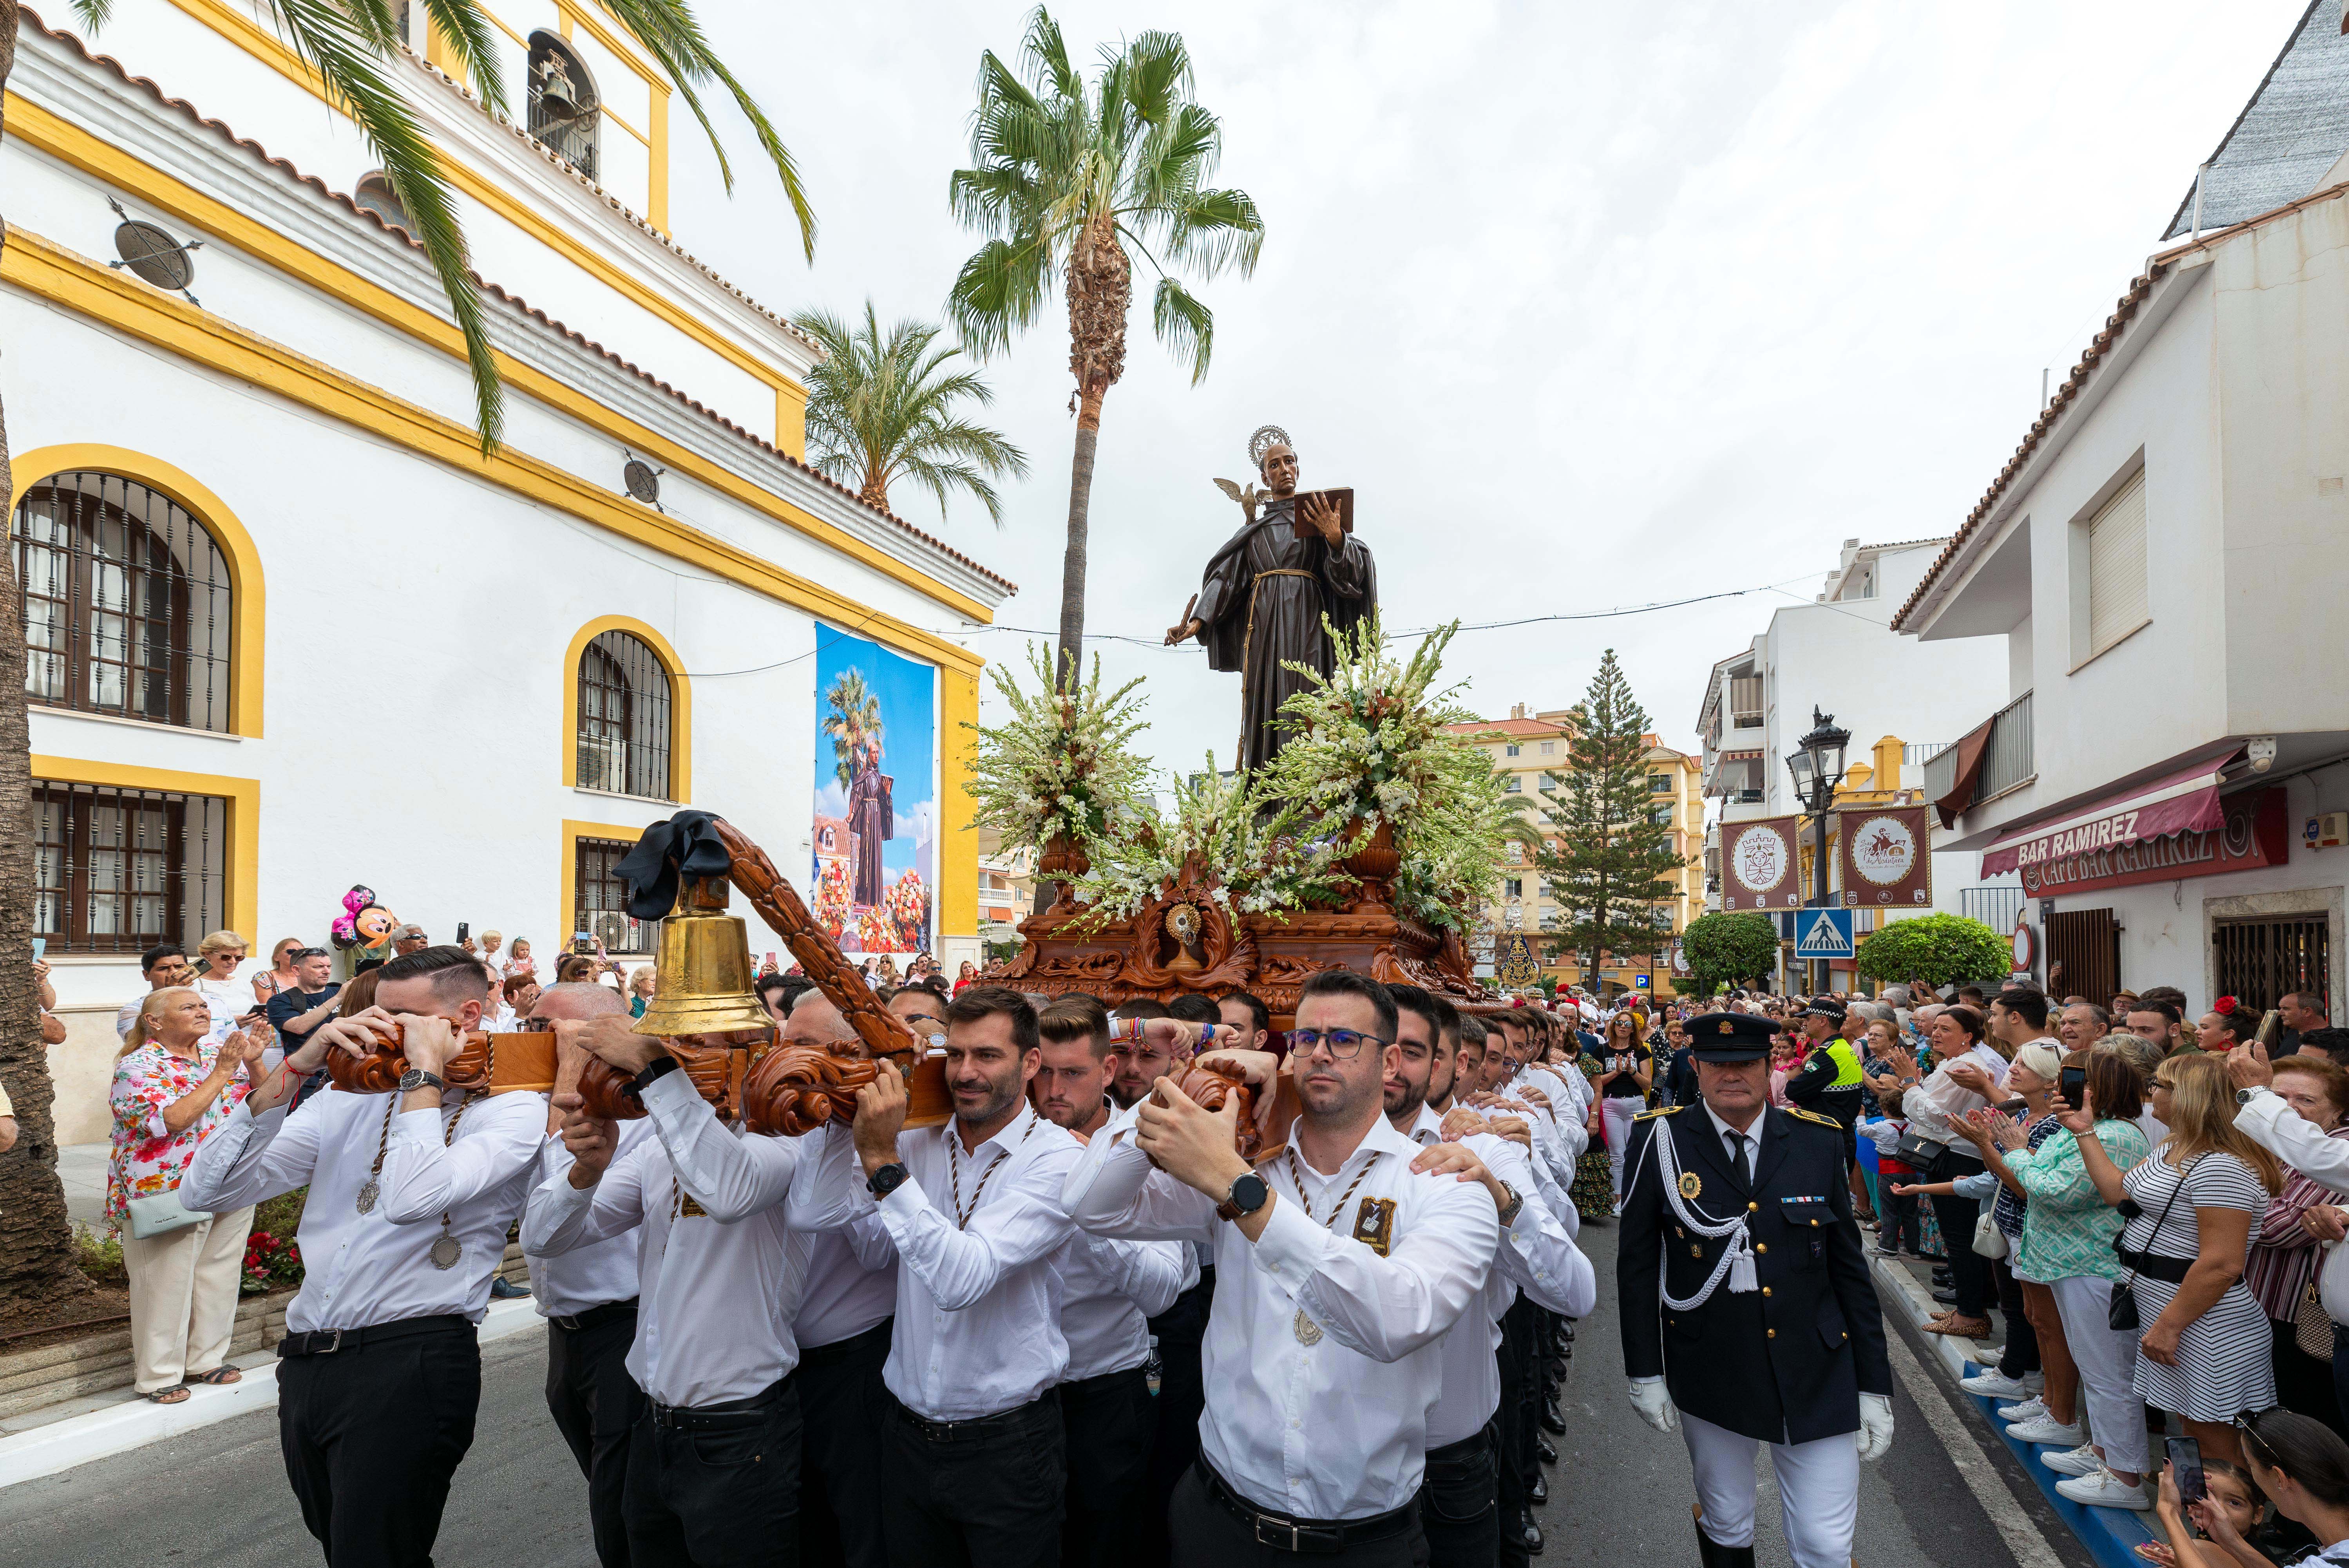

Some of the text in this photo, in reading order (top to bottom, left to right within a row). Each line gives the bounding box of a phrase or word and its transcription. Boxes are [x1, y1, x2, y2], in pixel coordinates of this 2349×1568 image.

[2018, 811, 2139, 866] BAR RAMIREZ
[2079, 852, 2113, 880] BAR
[2116, 829, 2214, 874] RAMIREZ
[1638, 977, 1646, 986] P
